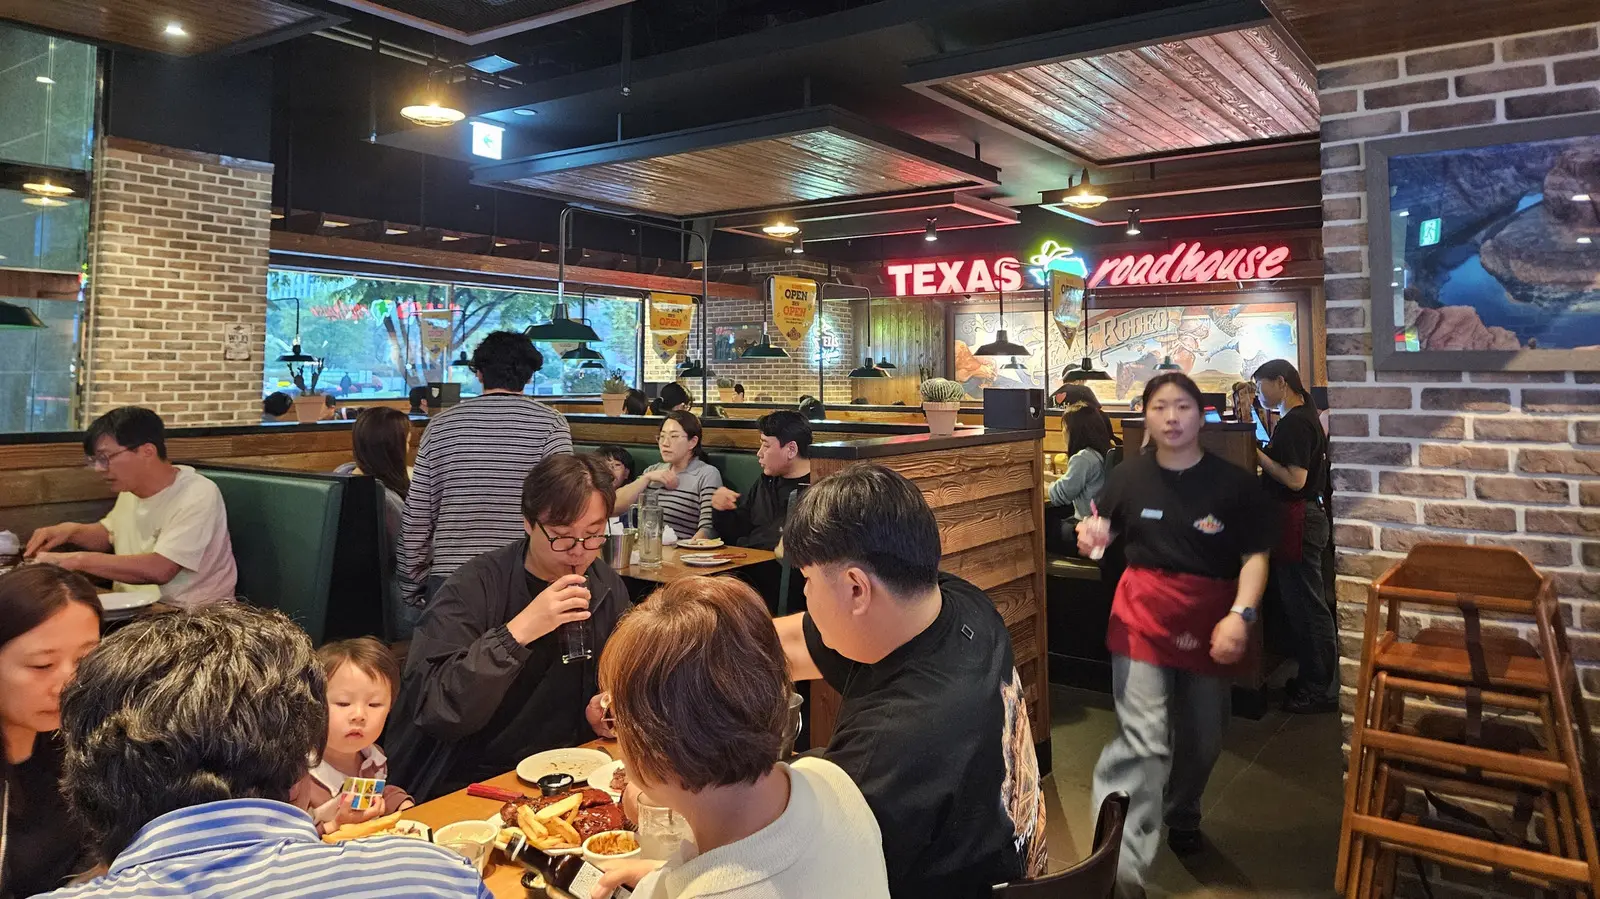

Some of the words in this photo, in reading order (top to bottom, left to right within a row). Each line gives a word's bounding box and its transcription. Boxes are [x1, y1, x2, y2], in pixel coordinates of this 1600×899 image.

[888, 257, 1023, 296] TEXAS
[1087, 242, 1289, 289] roadhouse
[784, 288, 808, 301] OPEN
[783, 305, 807, 317] OPEN
[659, 317, 682, 327] OPEN
